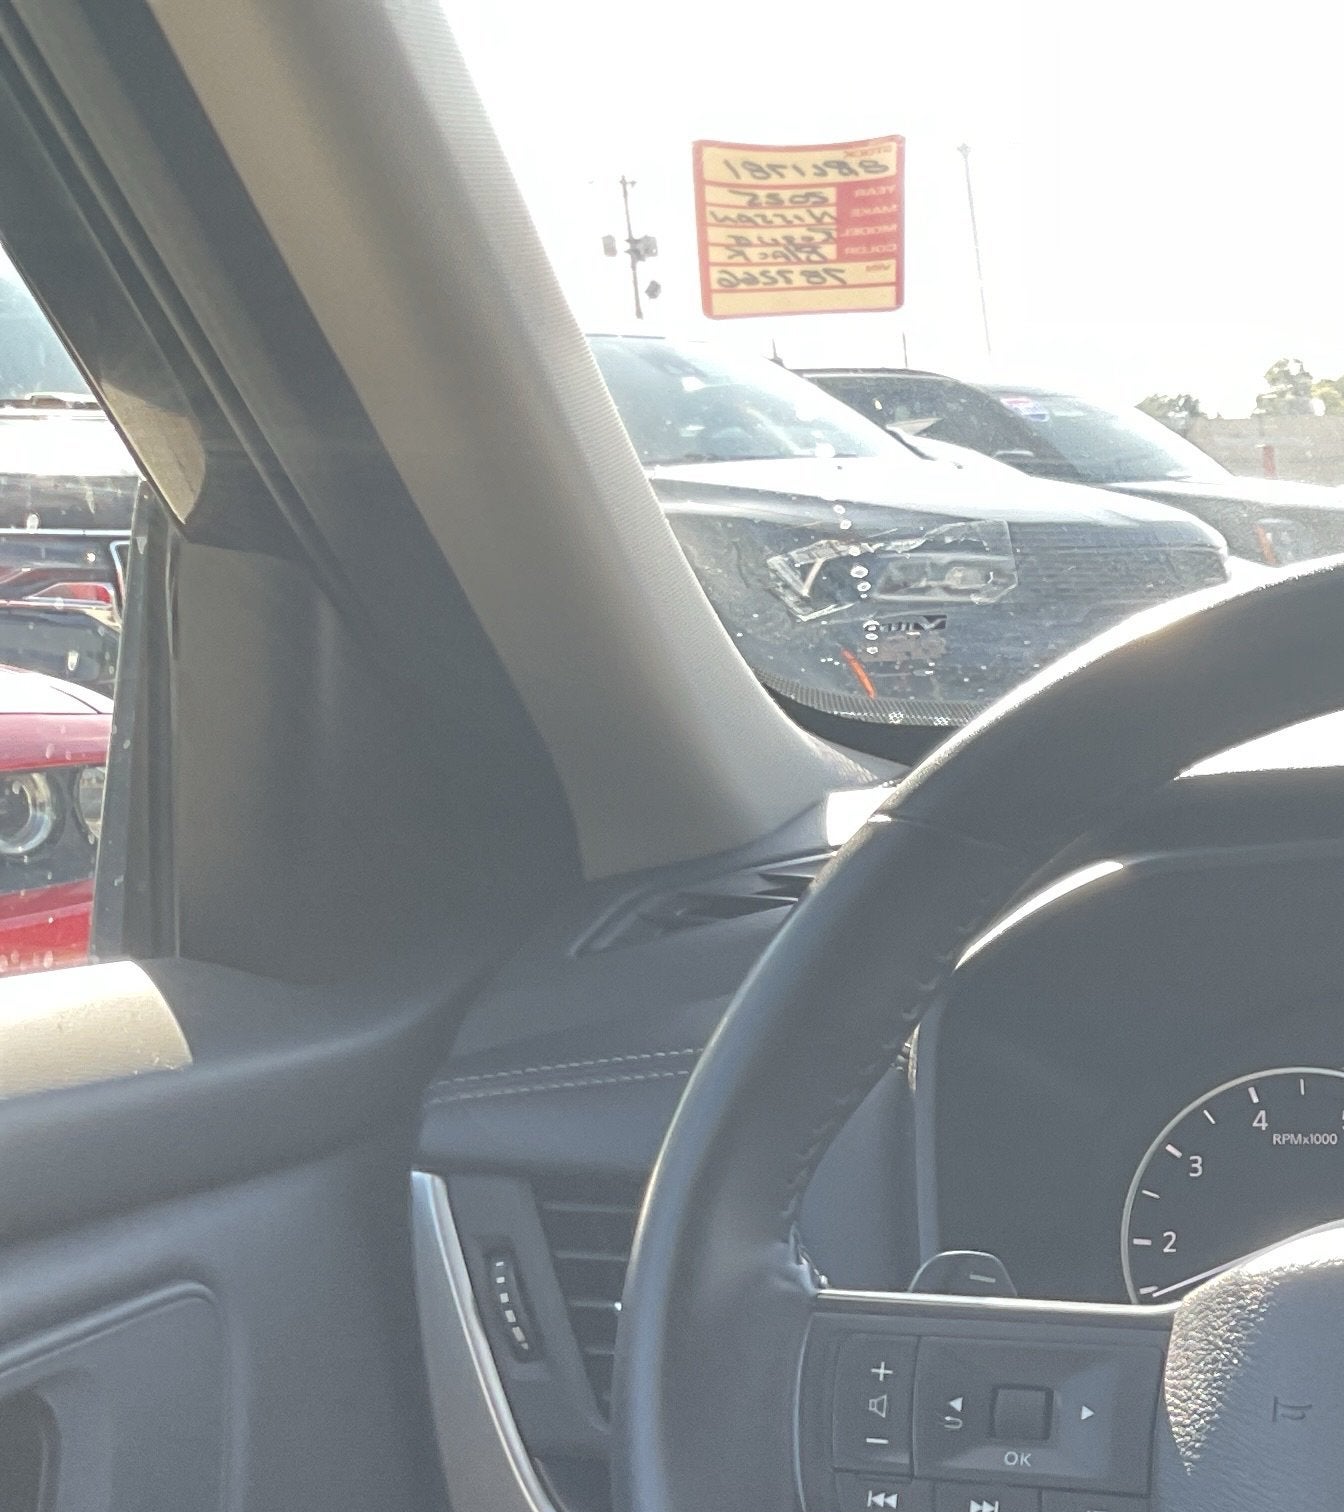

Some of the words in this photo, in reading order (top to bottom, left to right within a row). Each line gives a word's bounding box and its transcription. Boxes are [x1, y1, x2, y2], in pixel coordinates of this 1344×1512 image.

[1252, 1109, 1269, 1131] 4
[1272, 1133, 1338, 1146] RPMx1000
[1189, 1155, 1203, 1177] 3
[1162, 1231, 1177, 1253] 2
[1004, 1451, 1032, 1468] OK
